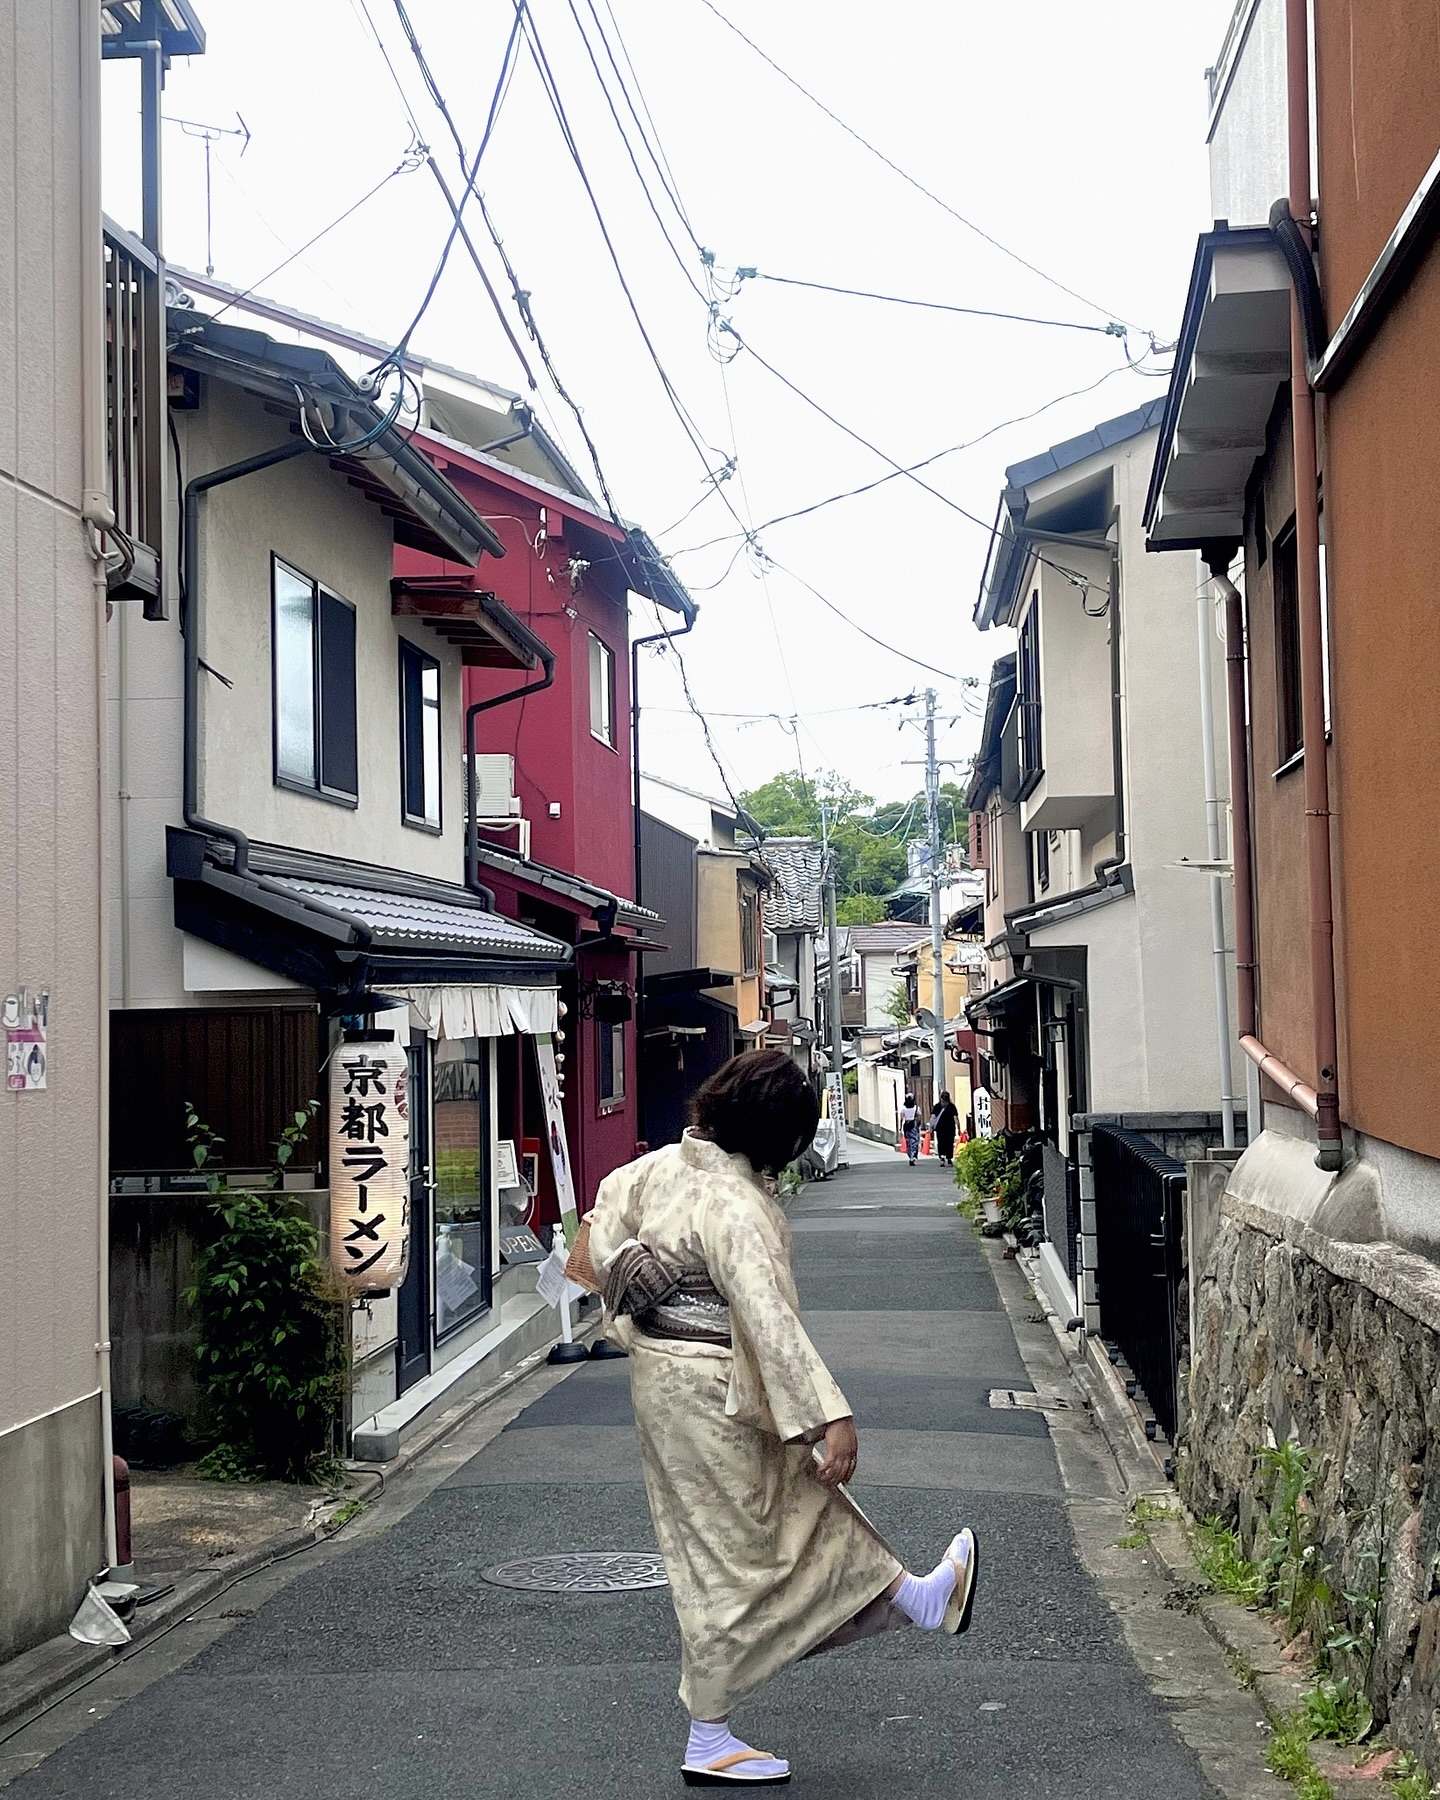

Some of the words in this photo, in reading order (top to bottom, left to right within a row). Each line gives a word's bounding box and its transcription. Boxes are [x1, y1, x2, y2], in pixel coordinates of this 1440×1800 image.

[337, 1054, 389, 1276] 京都ラーメン
[500, 1235, 542, 1254] OPEN
